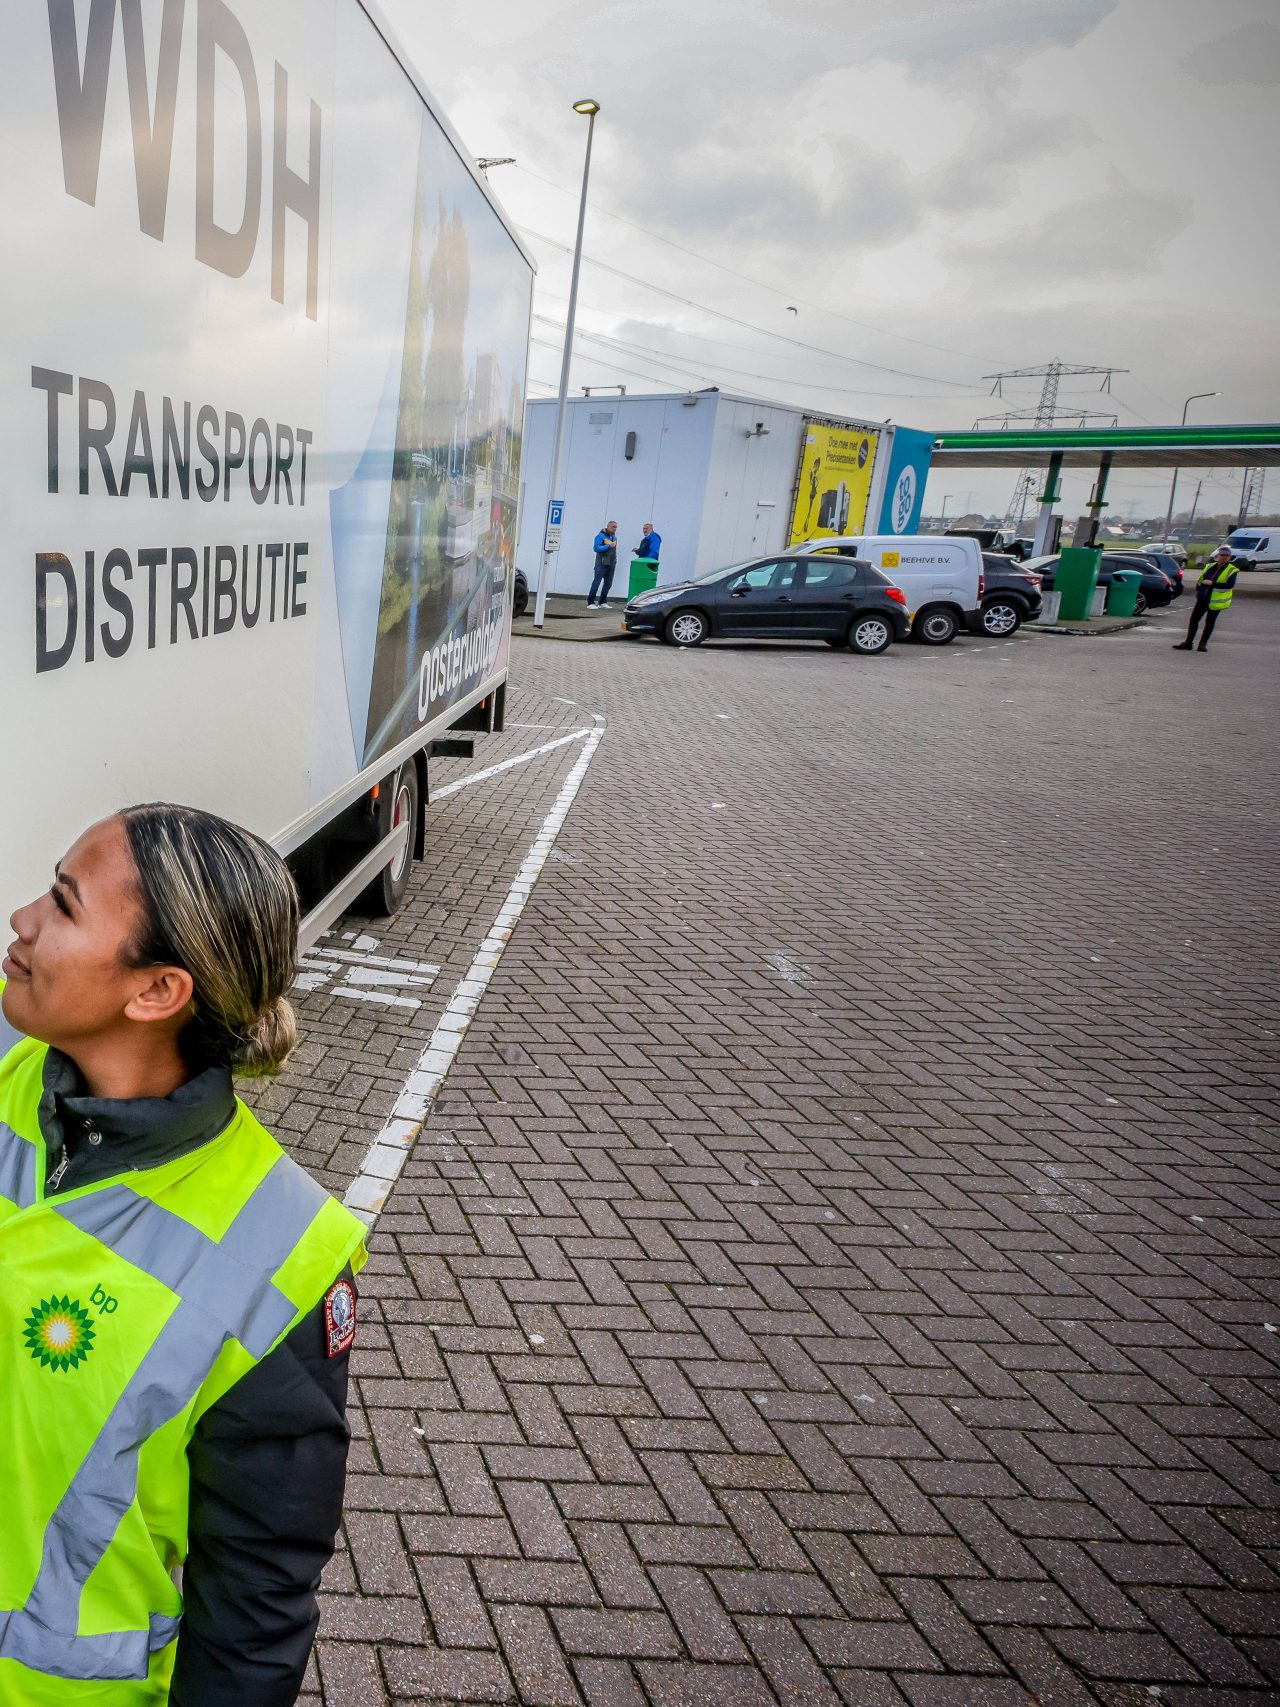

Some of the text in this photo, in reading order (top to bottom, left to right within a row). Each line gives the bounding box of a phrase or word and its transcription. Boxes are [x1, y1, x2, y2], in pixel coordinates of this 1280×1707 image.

[47, 0, 322, 322] WDH
[31, 365, 313, 506] TRANSPORT
[552, 509, 560, 523] P
[901, 556, 936, 564] BEEHIVE
[35, 542, 309, 674] DISTRIBUTIE
[89, 1283, 119, 1315] bp
